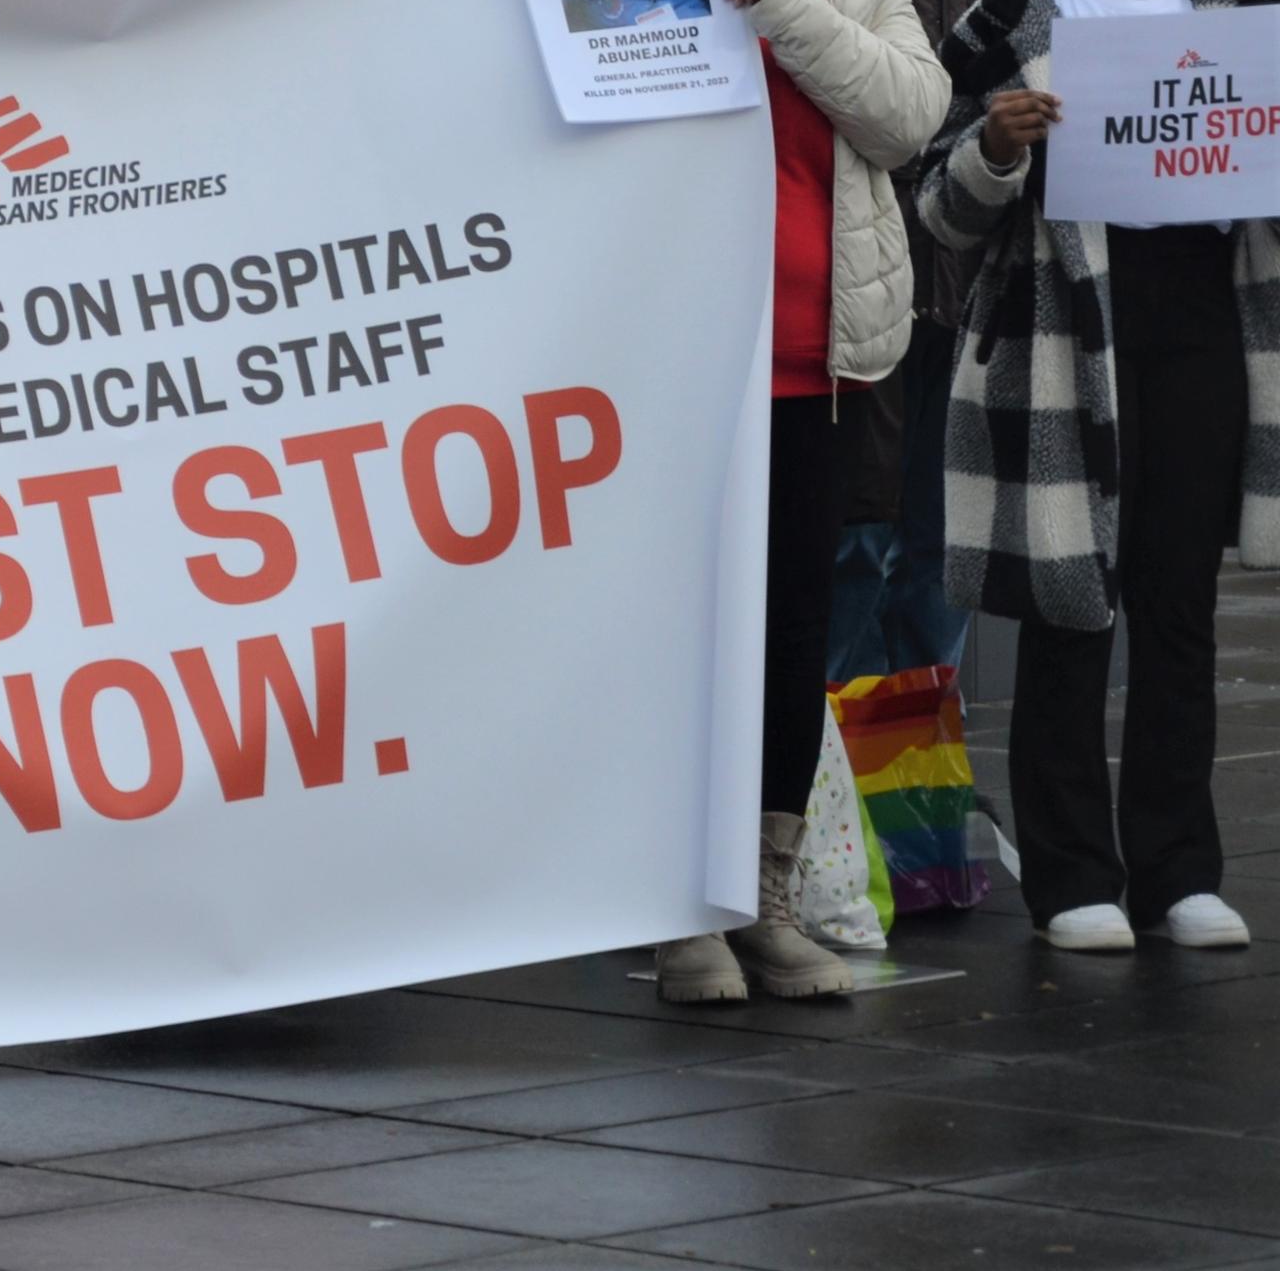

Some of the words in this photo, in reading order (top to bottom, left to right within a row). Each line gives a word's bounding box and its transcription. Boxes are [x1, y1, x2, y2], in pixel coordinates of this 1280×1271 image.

[588, 37, 611, 50] DR
[615, 25, 699, 48] MAHMOUD
[597, 42, 699, 65] ABUNEJAILA
[583, 87, 617, 99] KILLED
[618, 85, 633, 96] ON
[635, 81, 688, 95] NOVEMBER
[706, 76, 730, 87] 2023
[593, 71, 638, 83] GENERAL
[640, 63, 711, 79] PRACTITIONER
[1153, 79, 1181, 108] IT
[1188, 74, 1243, 107] ALL
[1104, 112, 1199, 145] MUST
[1154, 144, 1239, 178] NOW.
[11, 160, 141, 198] MEDECINS
[68, 174, 228, 218] FRONTIERES
[23, 277, 120, 347] ON
[132, 212, 515, 334] HOSPITALS
[236, 313, 446, 408] STAFF
[171, 385, 624, 607] STOP
